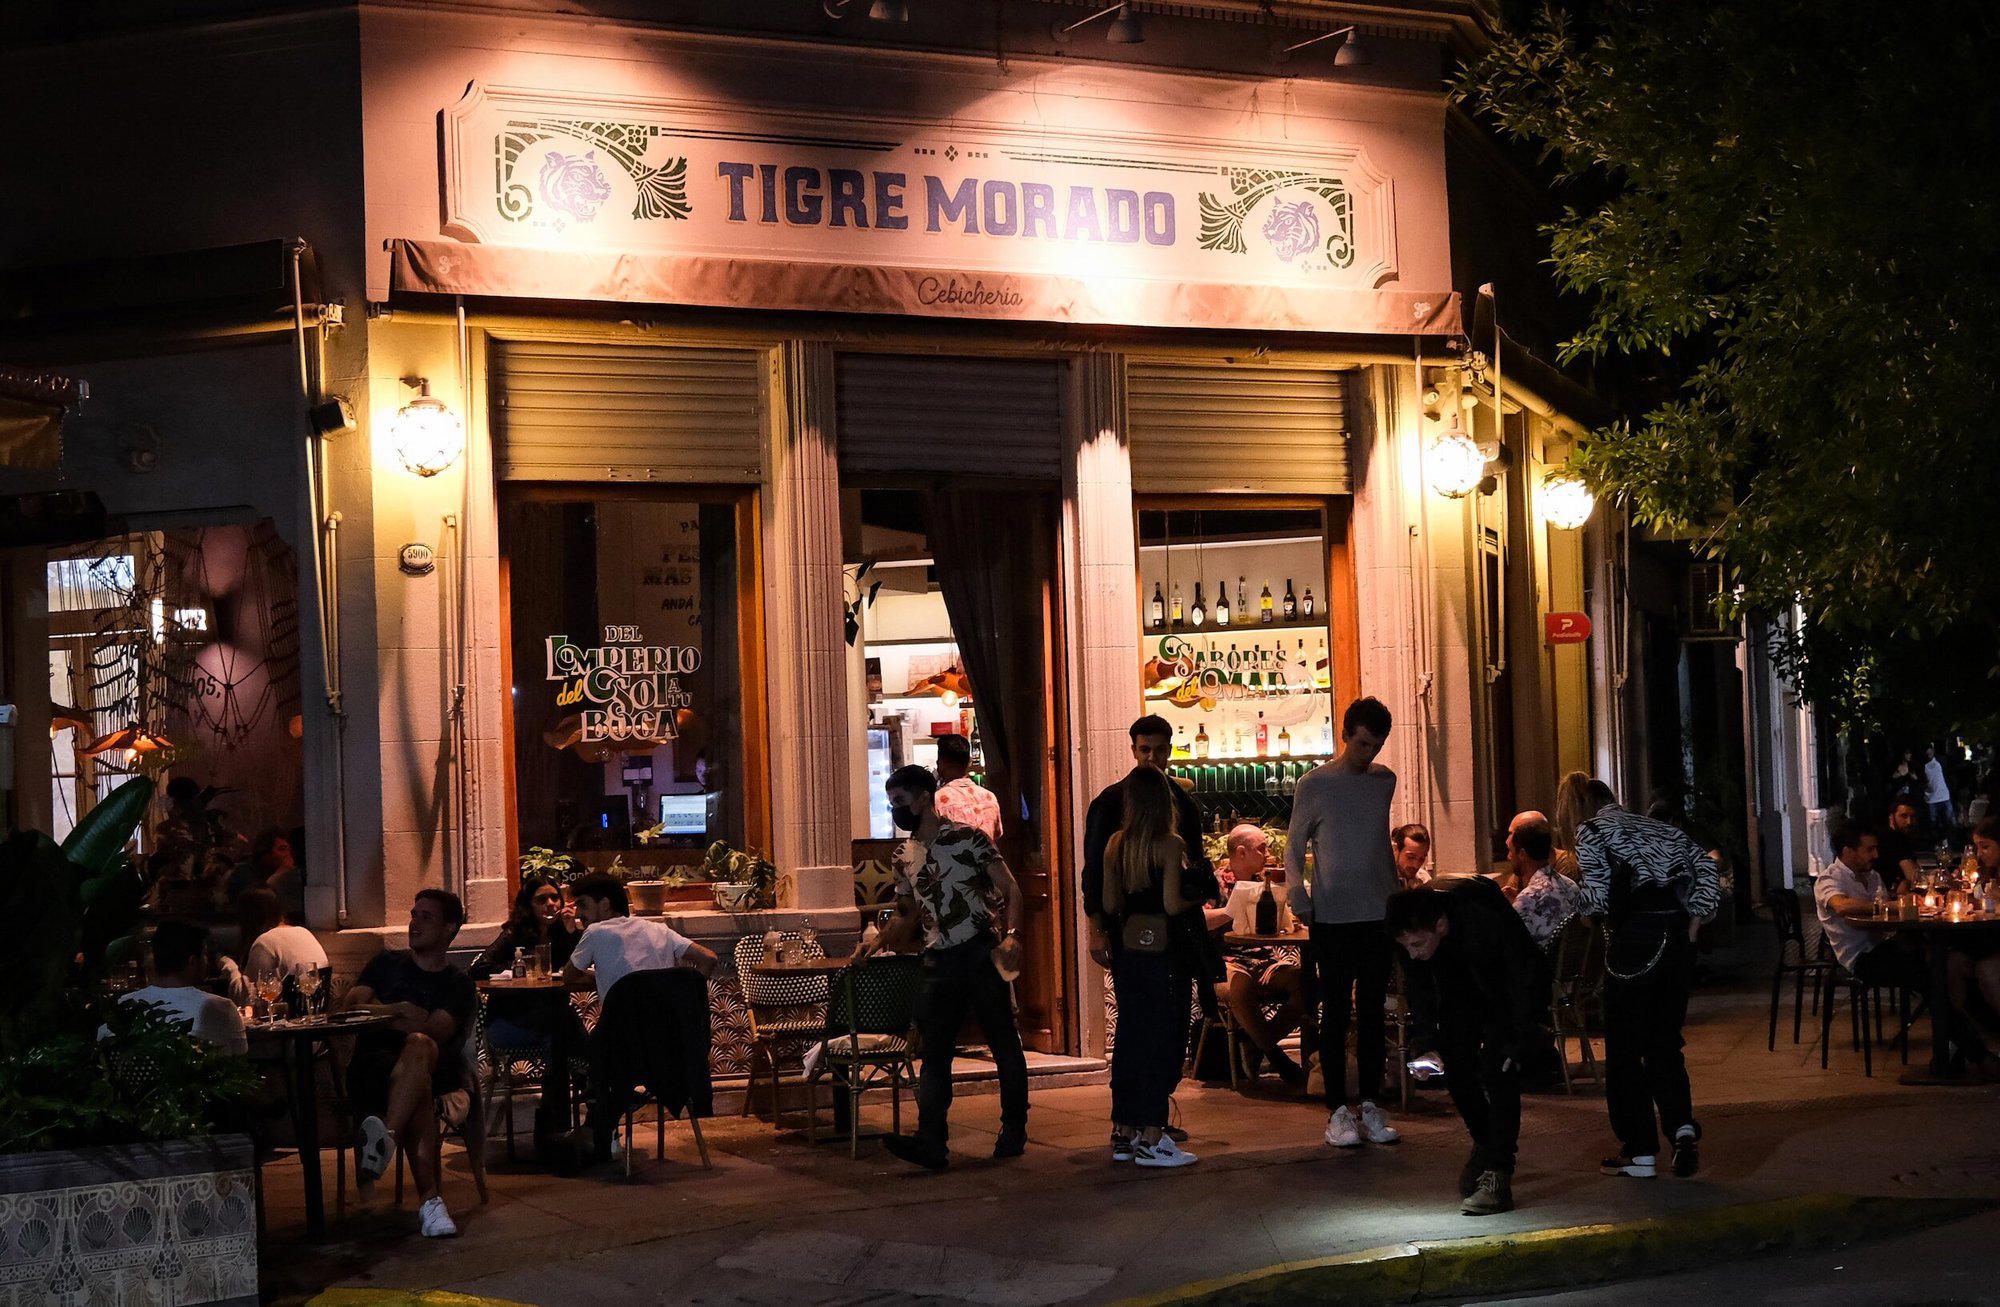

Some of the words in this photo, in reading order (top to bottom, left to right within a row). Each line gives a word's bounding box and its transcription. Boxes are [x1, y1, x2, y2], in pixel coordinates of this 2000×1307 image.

[716, 161, 908, 231] TIGRE
[924, 174, 1177, 248] MORADO
[407, 548, 429, 560] 5900
[605, 625, 643, 643] DEL
[1158, 634, 1287, 679] SABORES
[556, 678, 584, 706] del
[668, 692, 692, 708] TU
[581, 709, 679, 743] BOCA
